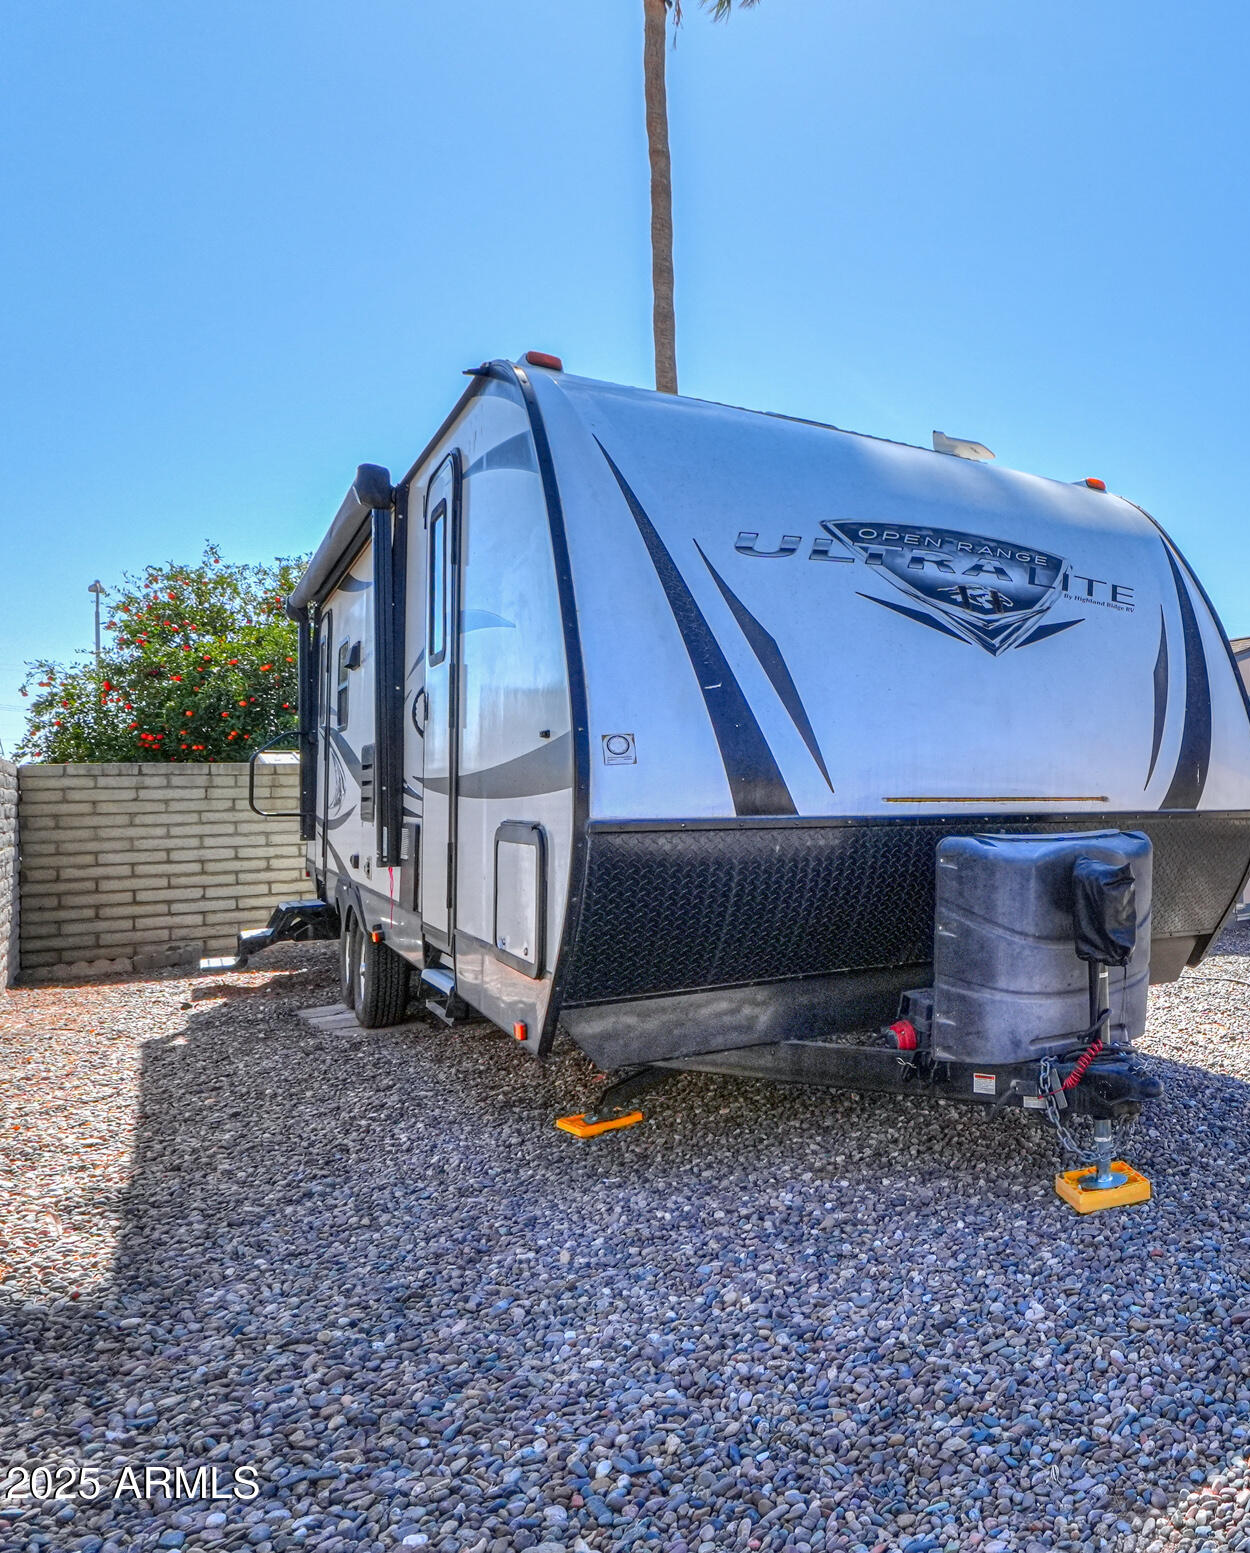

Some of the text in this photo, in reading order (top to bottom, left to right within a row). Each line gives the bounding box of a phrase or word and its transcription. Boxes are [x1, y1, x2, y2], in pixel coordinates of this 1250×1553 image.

[858, 528, 1048, 567] OPEN RANGE
[1074, 595, 1105, 607] Highland
